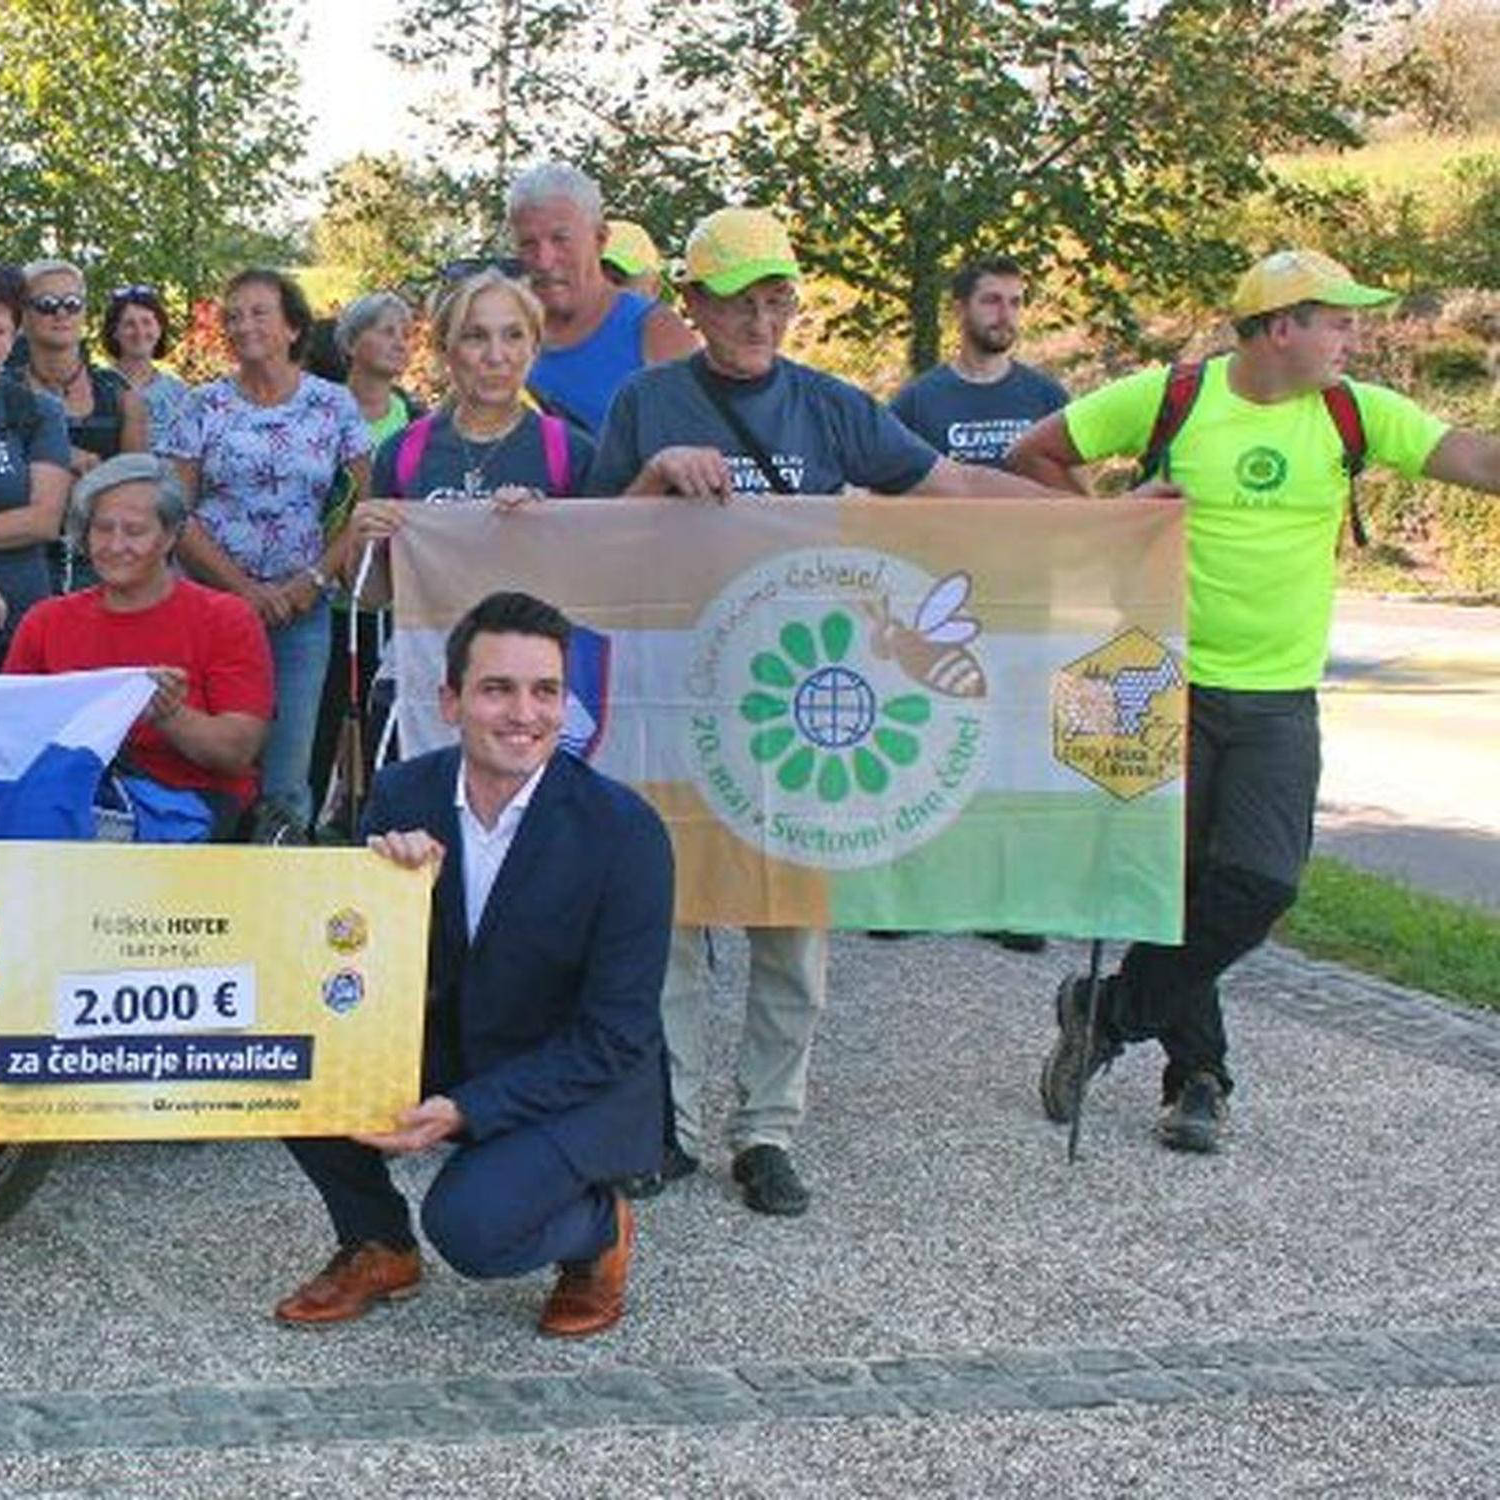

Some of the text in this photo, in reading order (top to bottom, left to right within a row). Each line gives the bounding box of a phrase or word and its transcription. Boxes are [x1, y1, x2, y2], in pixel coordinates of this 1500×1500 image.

[768, 811, 888, 851] Svetovni
[895, 789, 946, 832] dan
[73, 981, 238, 1026] 2.000 €
[7, 1044, 298, 1080] za čebelarje invalide
